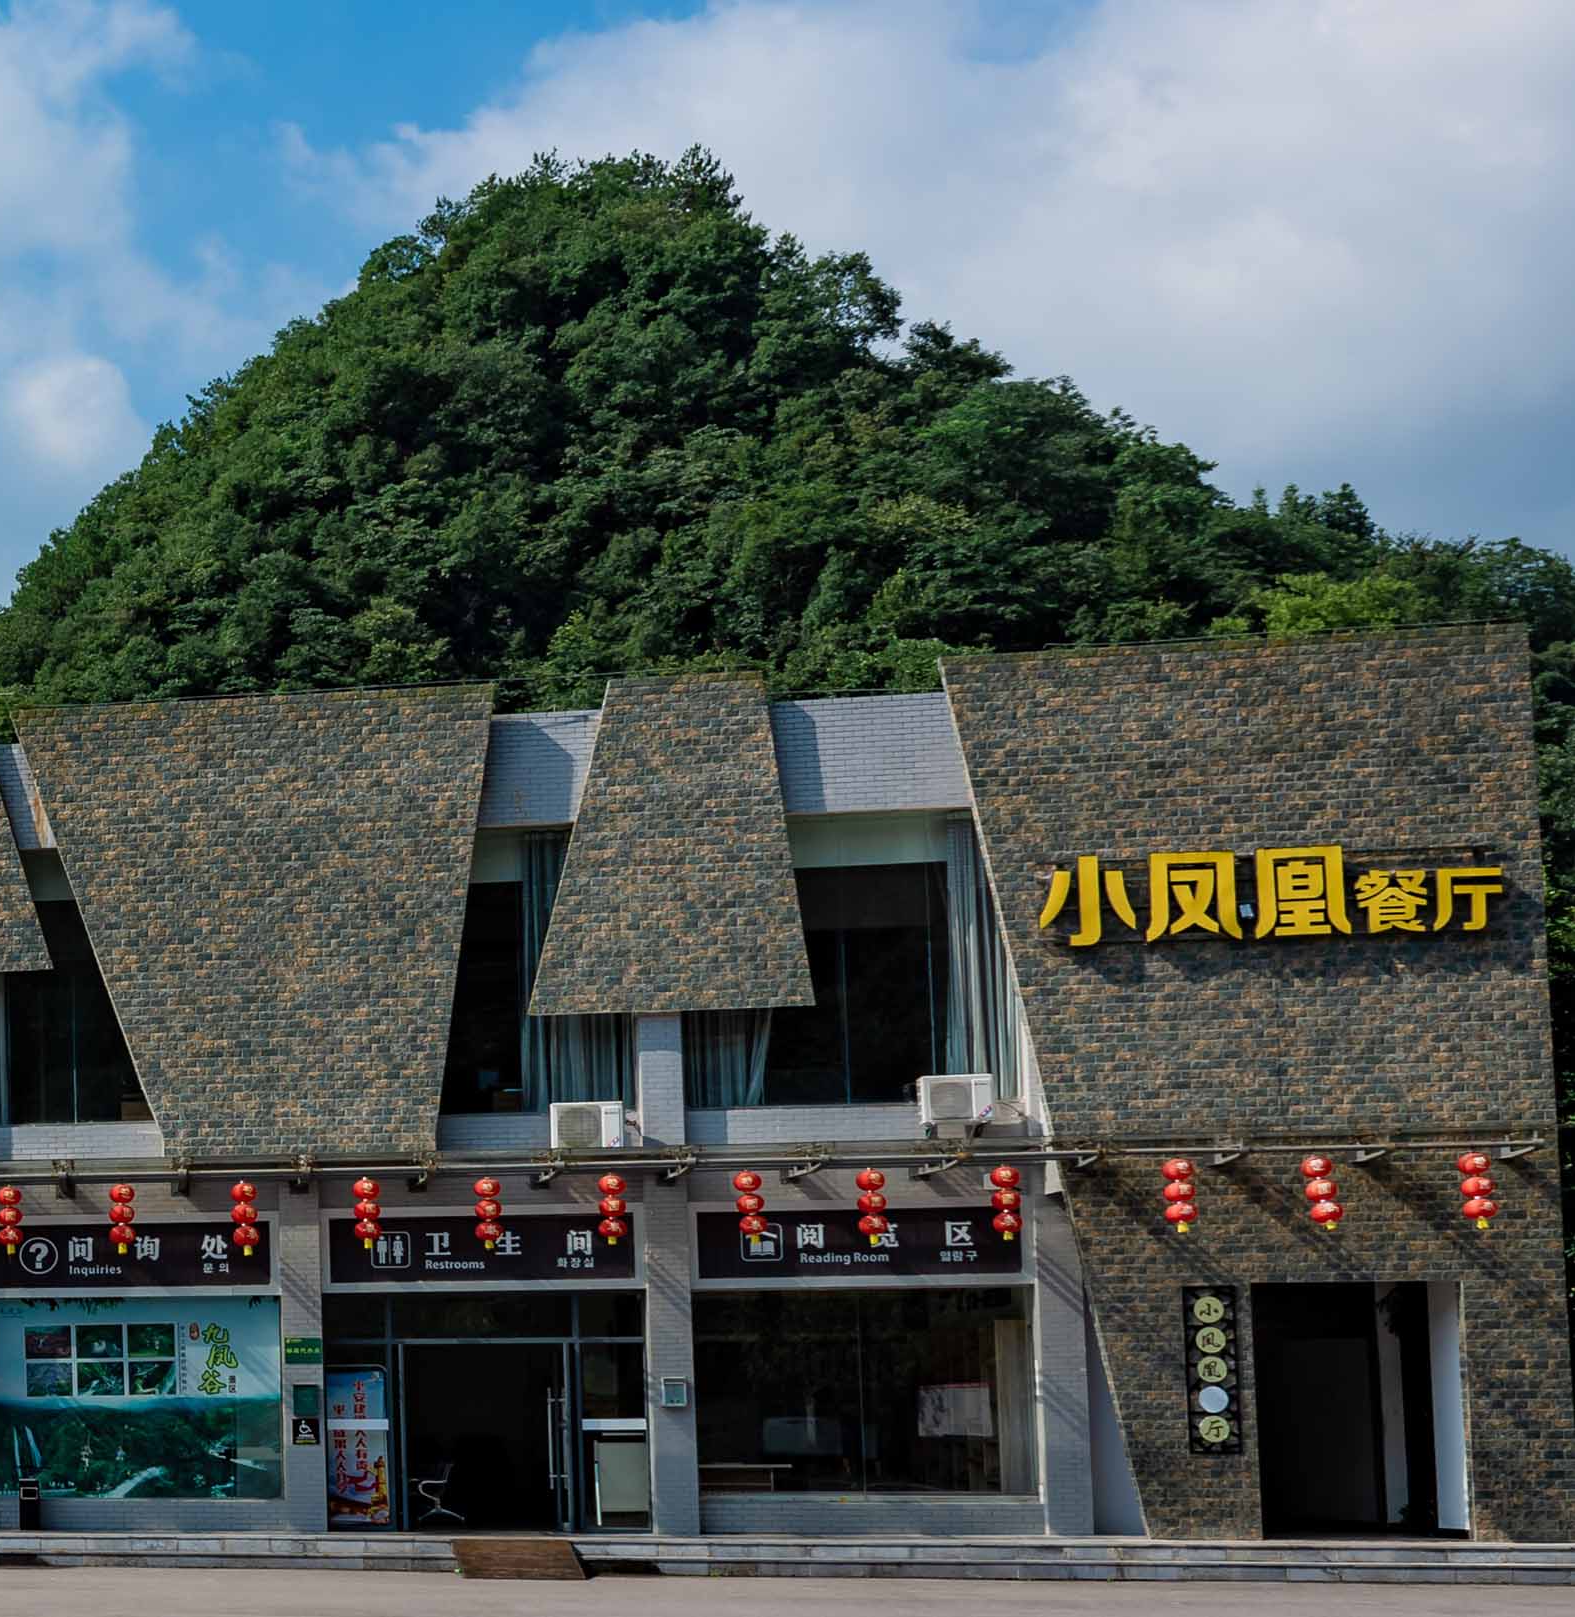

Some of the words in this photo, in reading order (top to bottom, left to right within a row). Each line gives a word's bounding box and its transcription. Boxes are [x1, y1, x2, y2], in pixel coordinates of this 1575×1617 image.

[1039, 845, 1503, 946] 小凤凰餐厅
[68, 1234, 229, 1263] 问询处
[423, 1229, 593, 1256] 卫生间
[424, 1259, 486, 1270] Restrooms
[799, 1252, 852, 1265] Reading
[852, 1251, 890, 1263] Room
[68, 1264, 123, 1277] Inquiries
